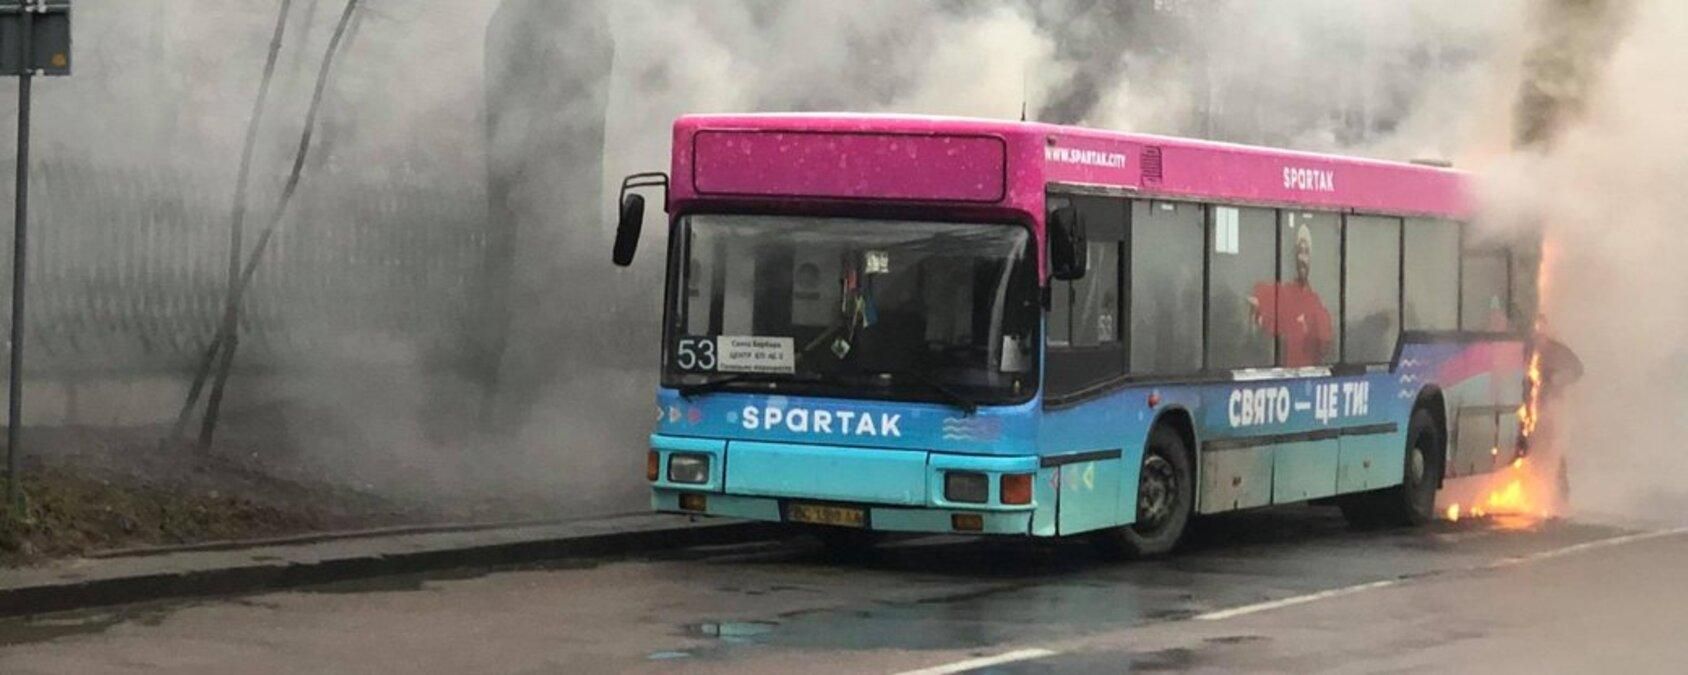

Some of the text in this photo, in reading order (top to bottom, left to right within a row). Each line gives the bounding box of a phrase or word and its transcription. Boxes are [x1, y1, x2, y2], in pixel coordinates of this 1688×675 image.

[1045, 147, 1126, 169] WWW.SPARTAK.CITY
[1283, 167, 1335, 192] SPARTAK
[678, 340, 715, 370] 53
[1228, 386, 1290, 428] СВЯТО
[1315, 383, 1339, 425] ЦЕ
[1343, 381, 1369, 417] ТИ!
[742, 405, 901, 437] SPARTAK
